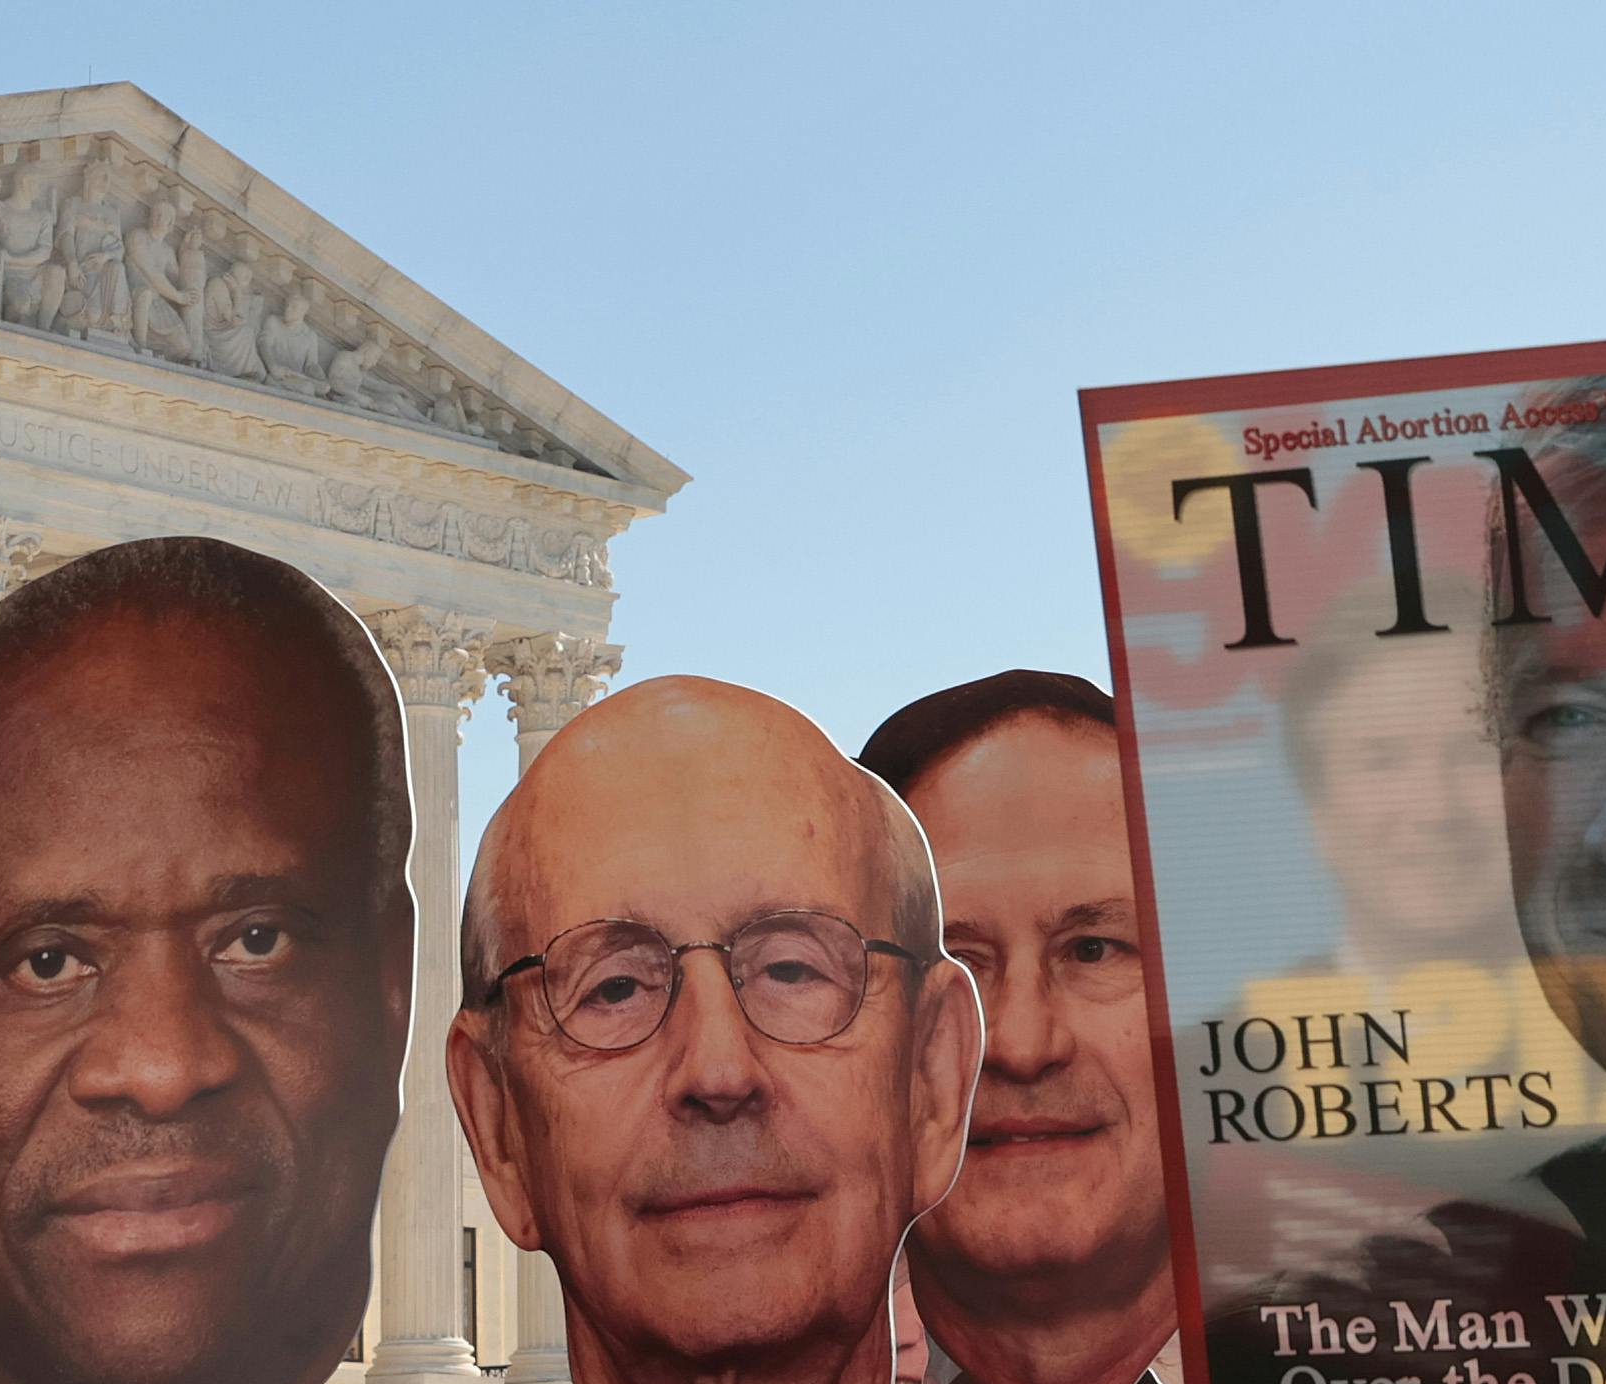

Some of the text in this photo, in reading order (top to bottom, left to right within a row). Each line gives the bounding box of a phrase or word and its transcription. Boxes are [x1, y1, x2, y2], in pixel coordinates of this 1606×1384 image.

[1242, 416, 1349, 461] Special
[1355, 406, 1491, 446] Abortion
[1499, 399, 1599, 432] Access
[1199, 1008, 1412, 1078] JOHN
[1201, 1070, 1558, 1144] ROBERTS
[1260, 1301, 1377, 1358] The
[1388, 1297, 1531, 1353] Man
